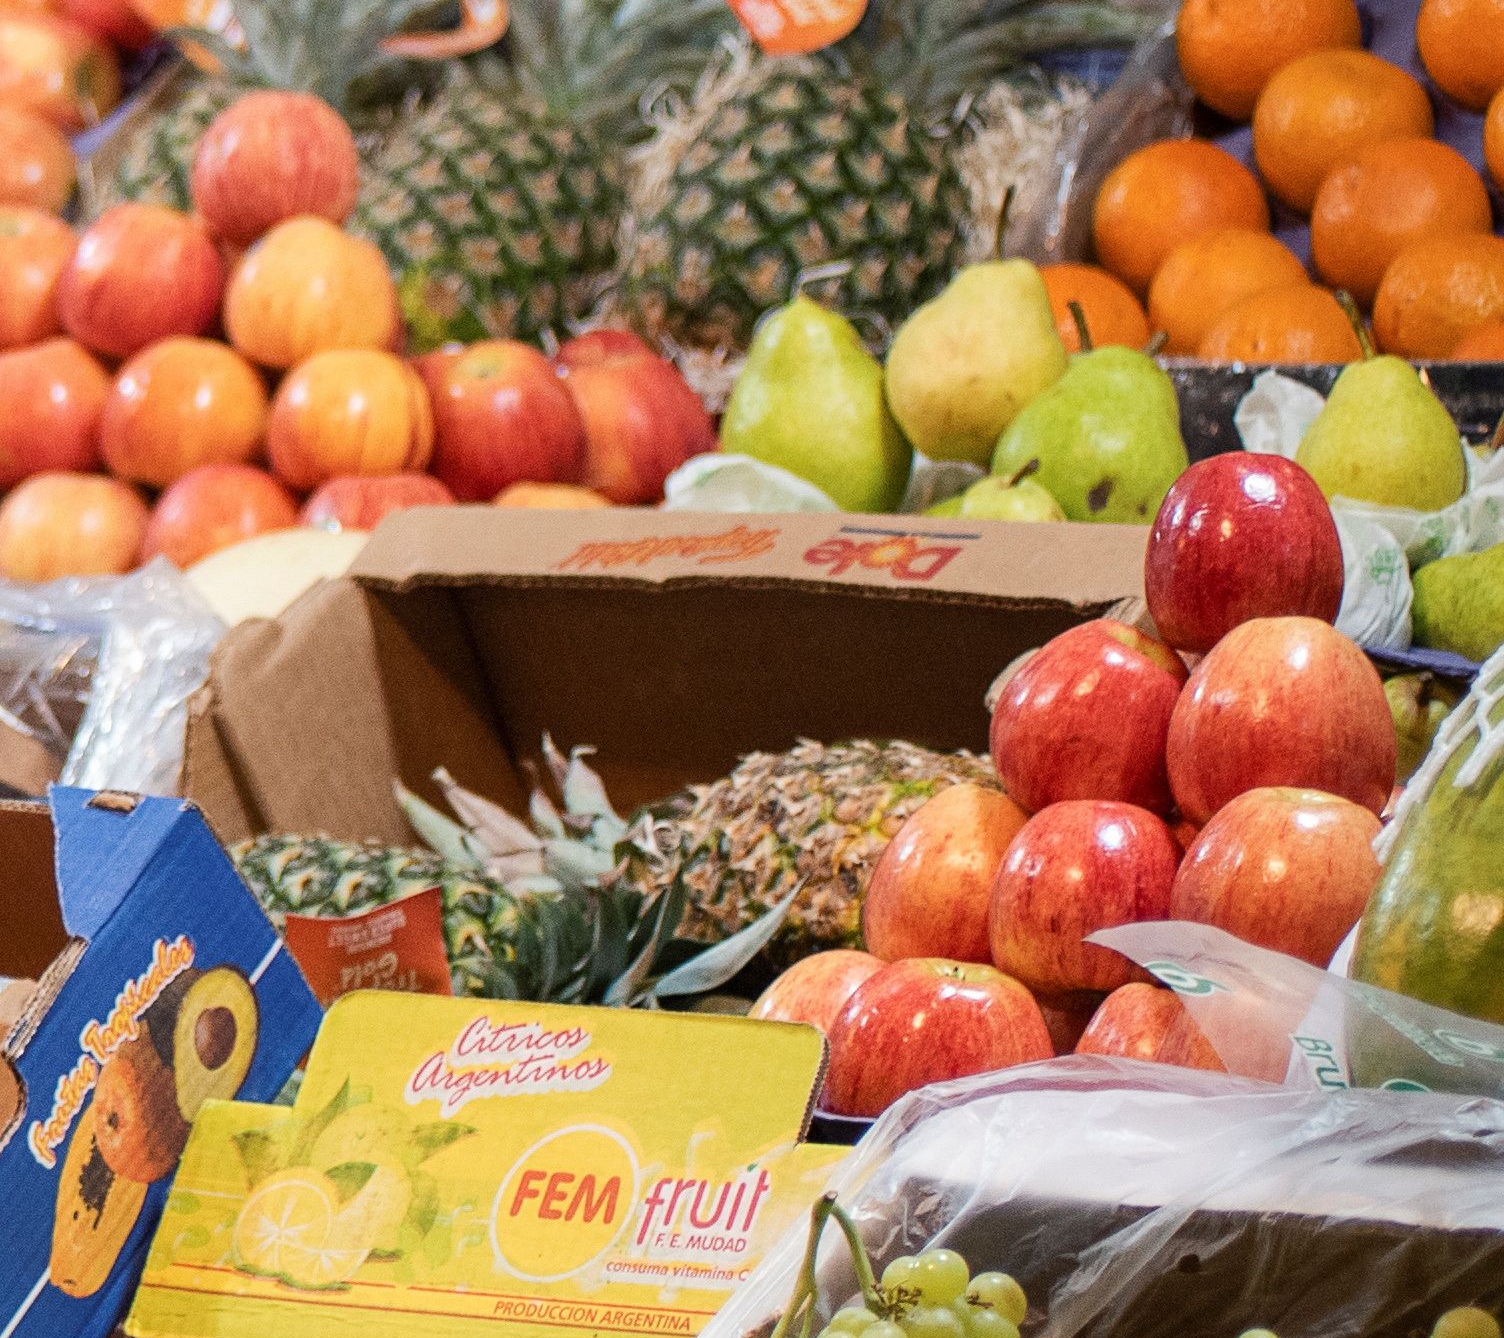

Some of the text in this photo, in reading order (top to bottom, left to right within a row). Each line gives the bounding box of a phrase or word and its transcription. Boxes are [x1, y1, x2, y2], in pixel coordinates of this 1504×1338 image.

[803, 536, 962, 582] Dole
[412, 1054, 609, 1106] Argentinos
[509, 1163, 770, 1246] FEM fruit
[686, 1235, 747, 1253] MUDAD
[605, 1260, 666, 1276] consuma
[671, 1263, 735, 1280] vitamina
[493, 1300, 692, 1332] PRODUCCION ARGENTINA
